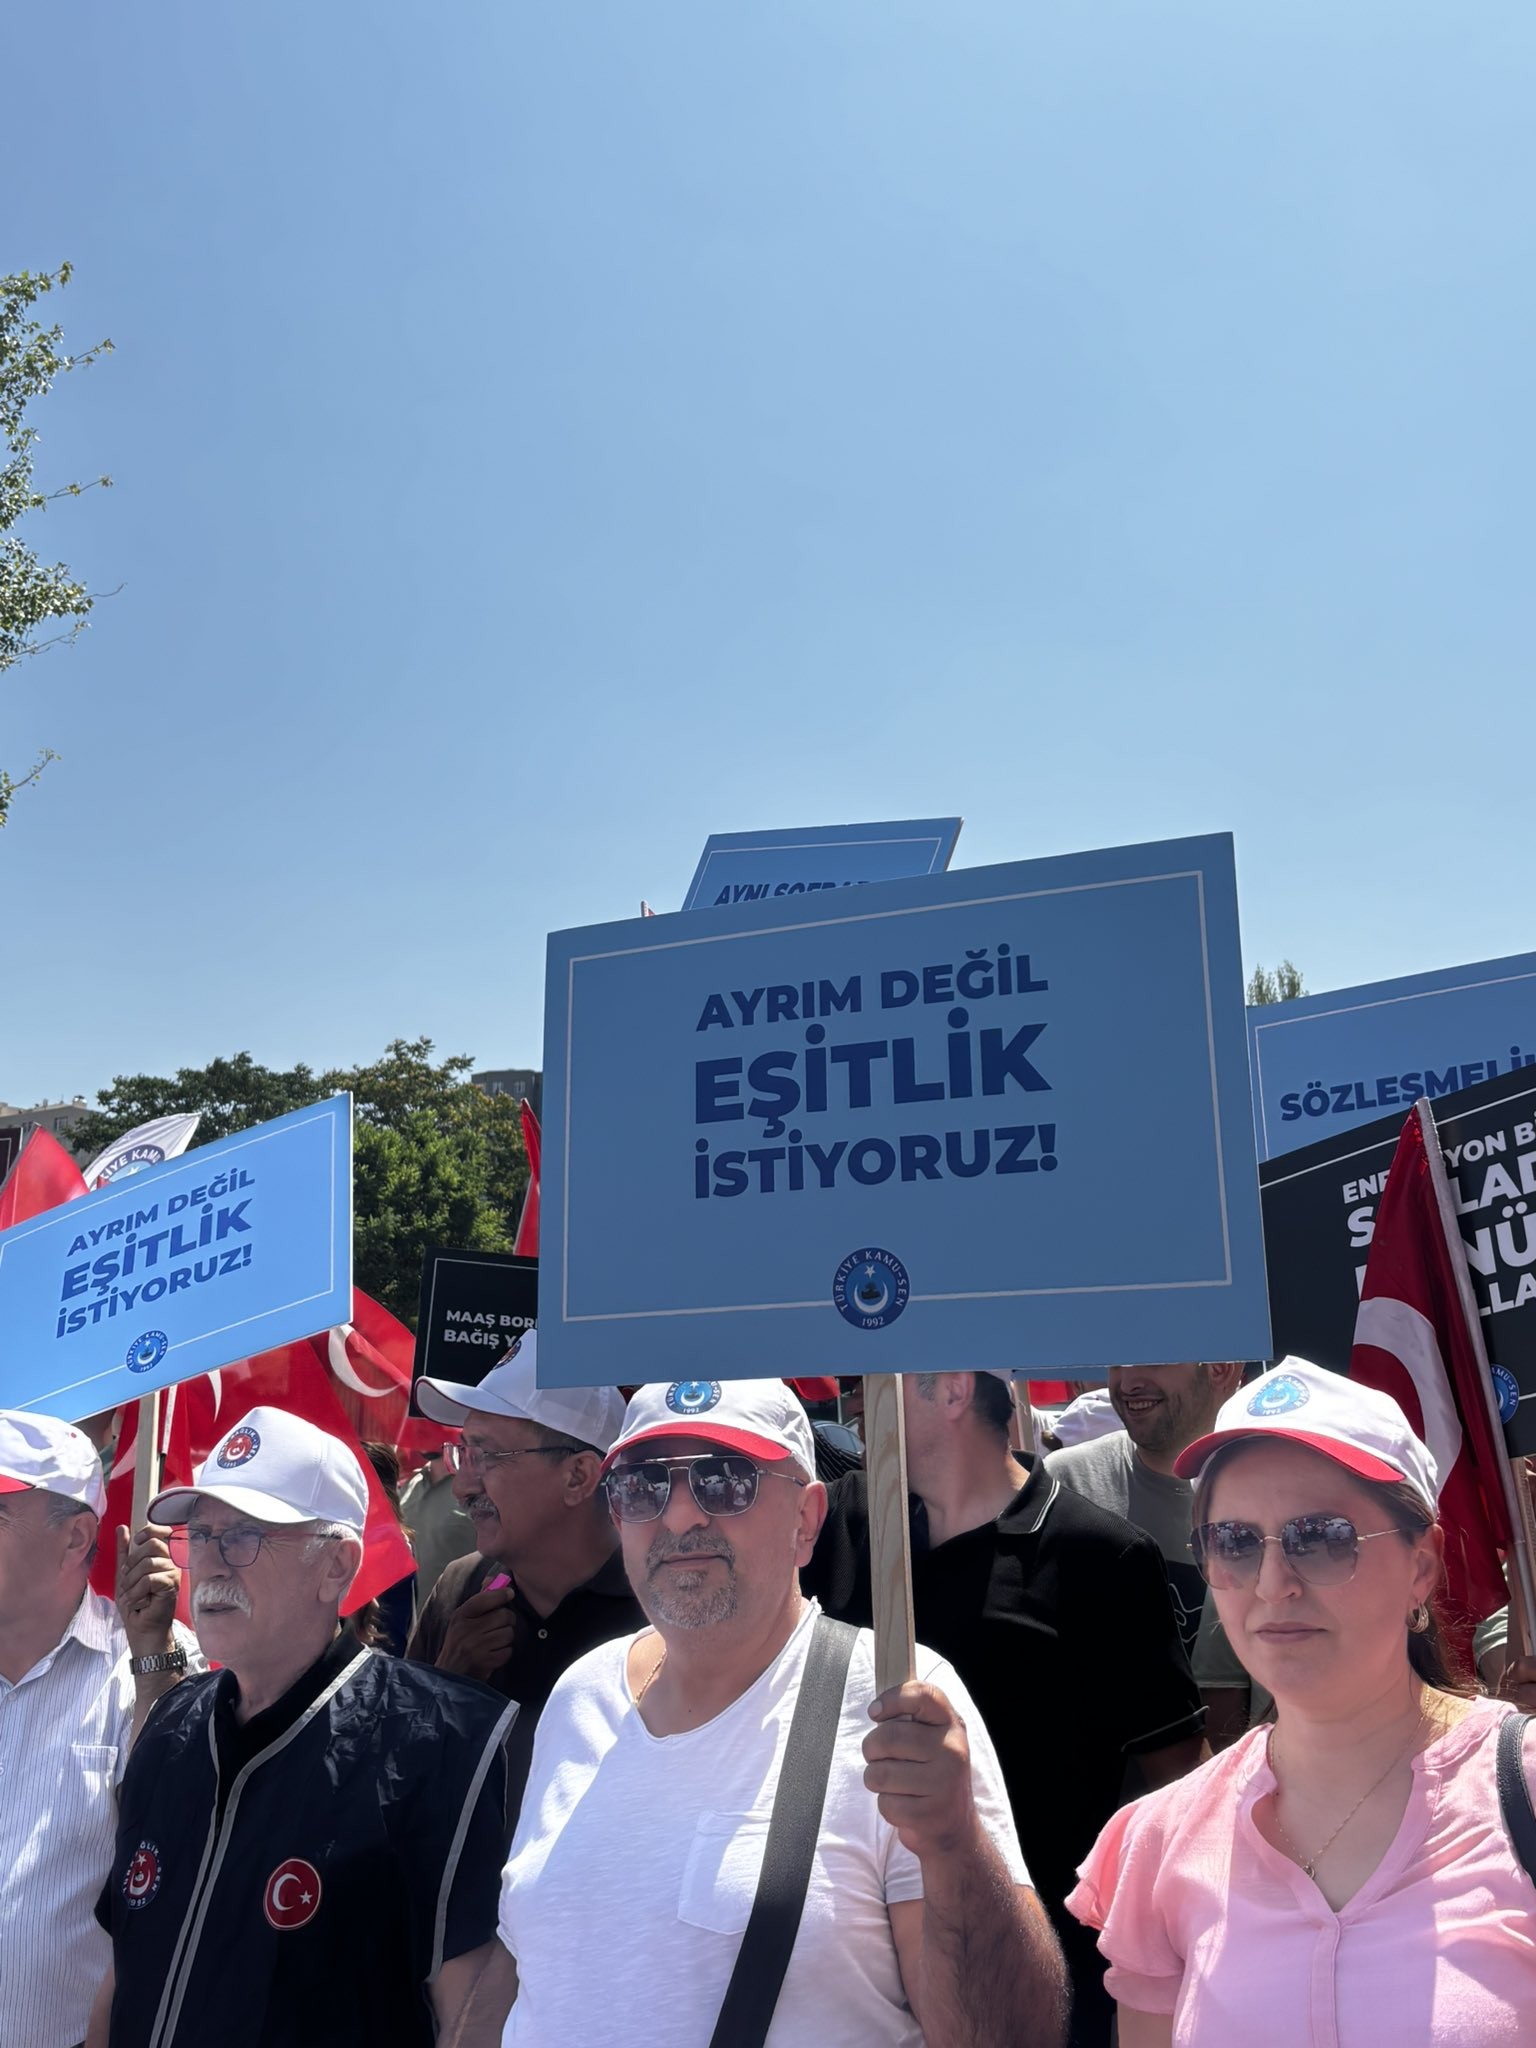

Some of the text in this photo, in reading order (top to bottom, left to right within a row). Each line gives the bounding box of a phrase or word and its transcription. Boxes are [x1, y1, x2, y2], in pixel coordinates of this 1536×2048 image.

[713, 882, 770, 906] AYNI
[695, 943, 1049, 1032] AYRIM DEĞİL
[695, 1006, 1054, 1139] EŞİTLİK
[694, 1123, 1059, 1200] İSTİYORUZ!
[61, 1198, 253, 1302] EŞİTLİK
[66, 1167, 256, 1257] AYRIM DEĞİL
[56, 1243, 253, 1339] İSTİYORUZ!
[446, 1309, 538, 1329] MAAŞ BOR
[834, 1250, 908, 1311] TÜRKİYE KAMU-SEN
[443, 1328, 500, 1350] BAĞIŞ
[861, 1316, 886, 1328] 1992
